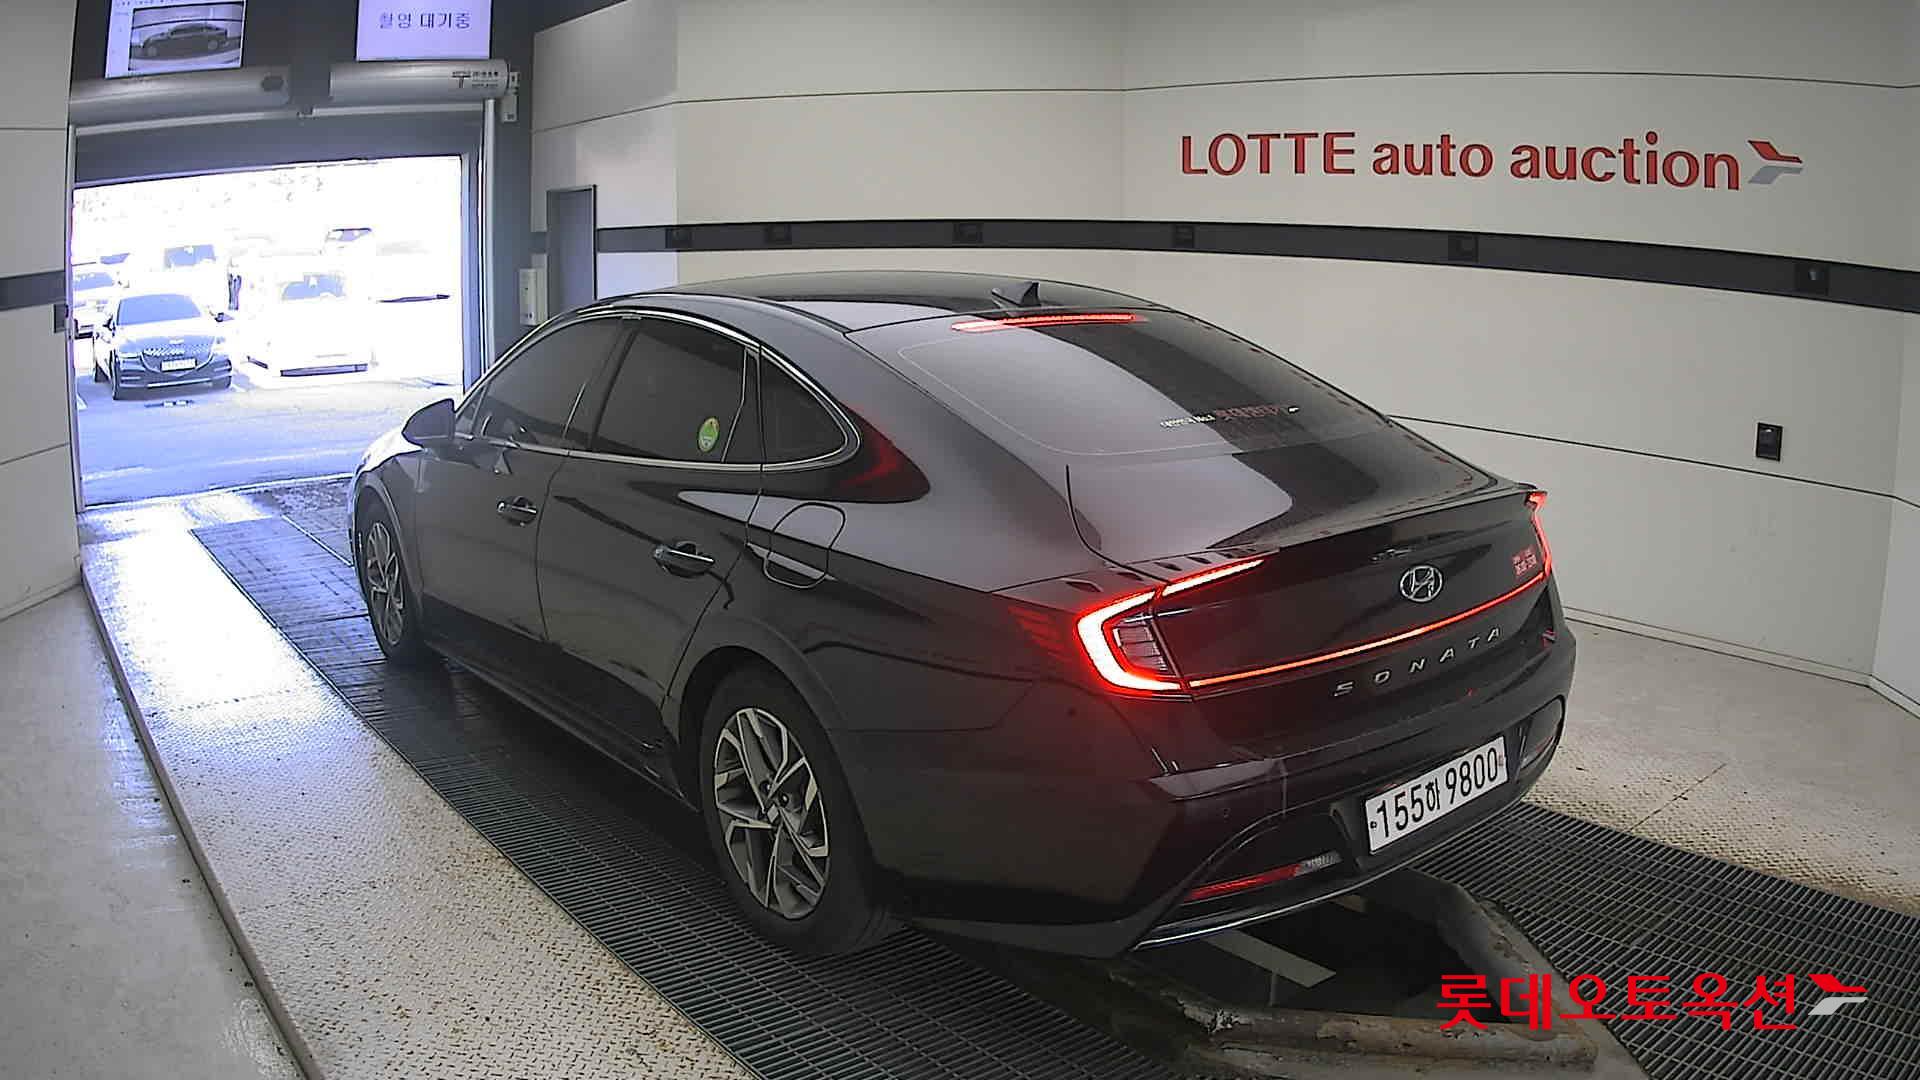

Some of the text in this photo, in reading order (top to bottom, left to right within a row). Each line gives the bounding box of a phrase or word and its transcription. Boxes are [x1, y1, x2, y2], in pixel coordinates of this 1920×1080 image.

[420, 12, 471, 29] 대기중
[1181, 131, 1741, 191] LOTTE auto auction
[1334, 627, 1500, 697] SONATA
[1376, 747, 1499, 838] 155하 9800
